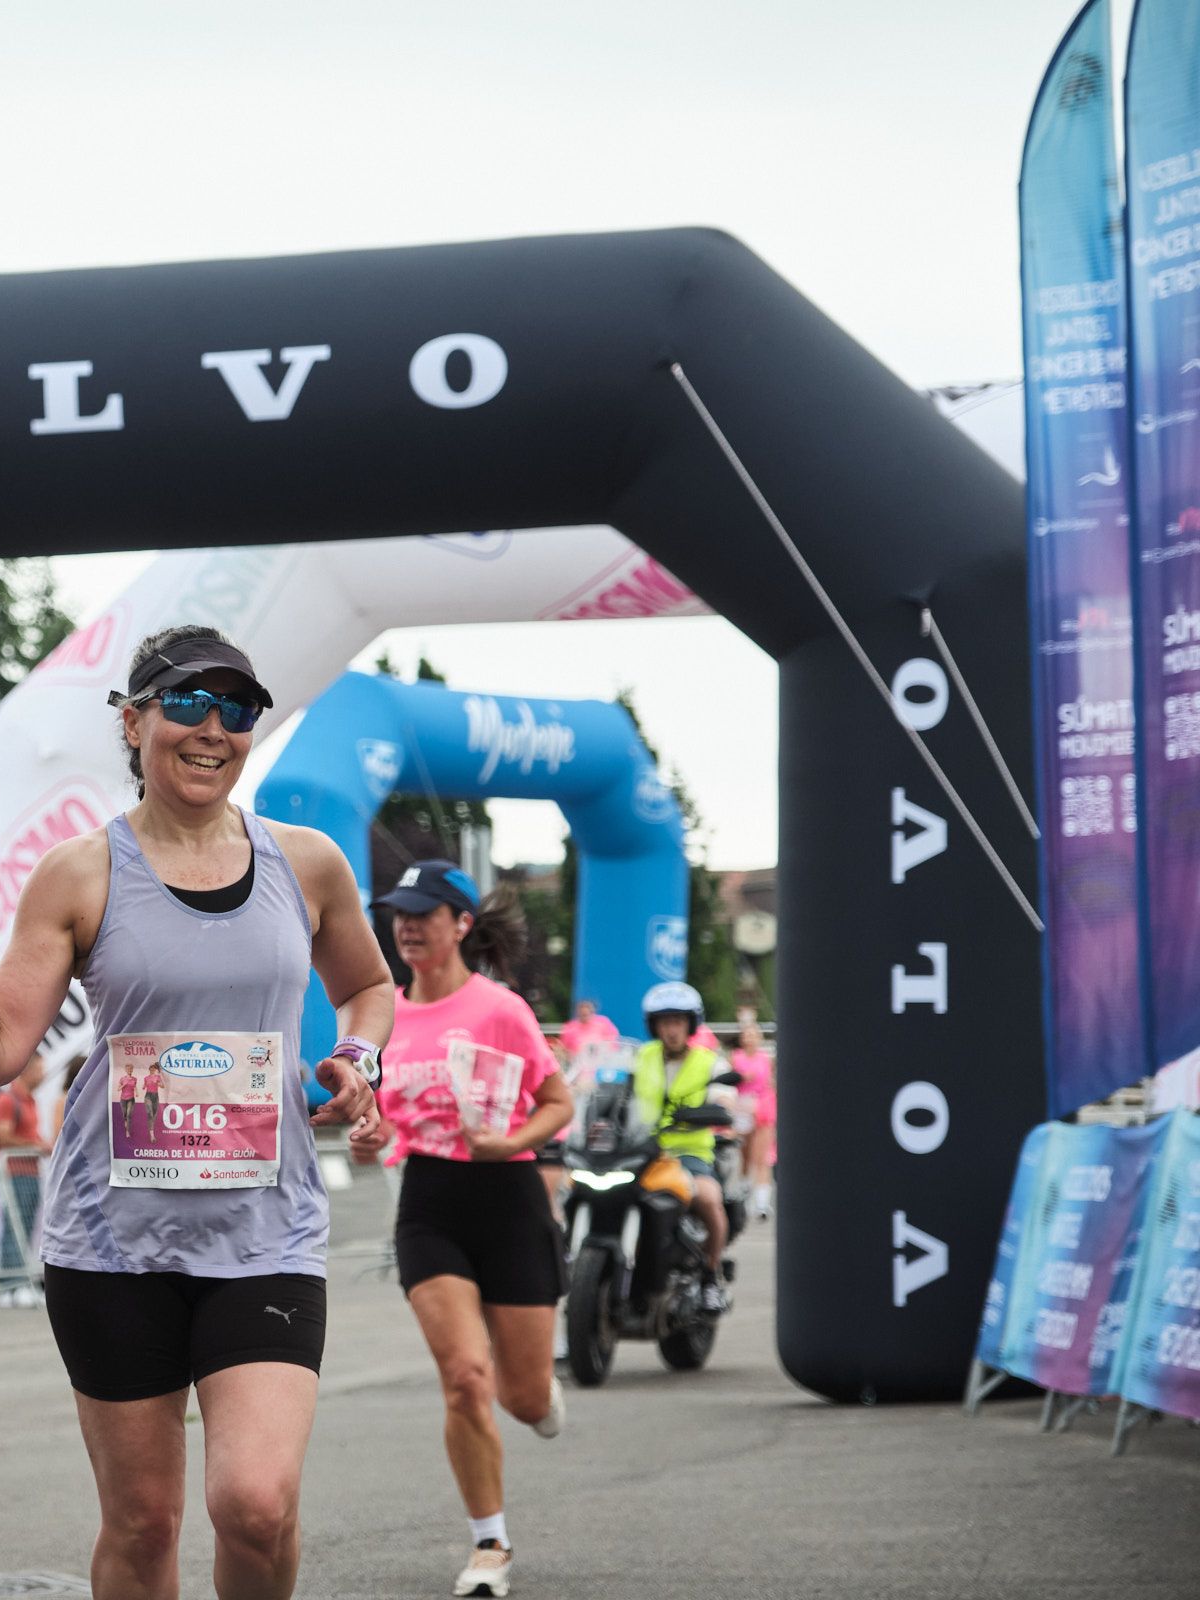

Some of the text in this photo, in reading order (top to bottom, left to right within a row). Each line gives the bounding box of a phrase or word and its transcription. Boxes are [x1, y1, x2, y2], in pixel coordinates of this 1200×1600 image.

[890, 657, 950, 1307] VOLVO
[124, 1046, 156, 1056] SUMA
[164, 1054, 228, 1069] ASTURIANA
[162, 1103, 228, 1130] 016
[180, 1135, 211, 1146] 1372
[133, 1147, 256, 1159] CARRERA DE LA MUJER GIJÓN
[128, 1166, 179, 1180] OYSHO
[213, 1169, 260, 1180] Santander
